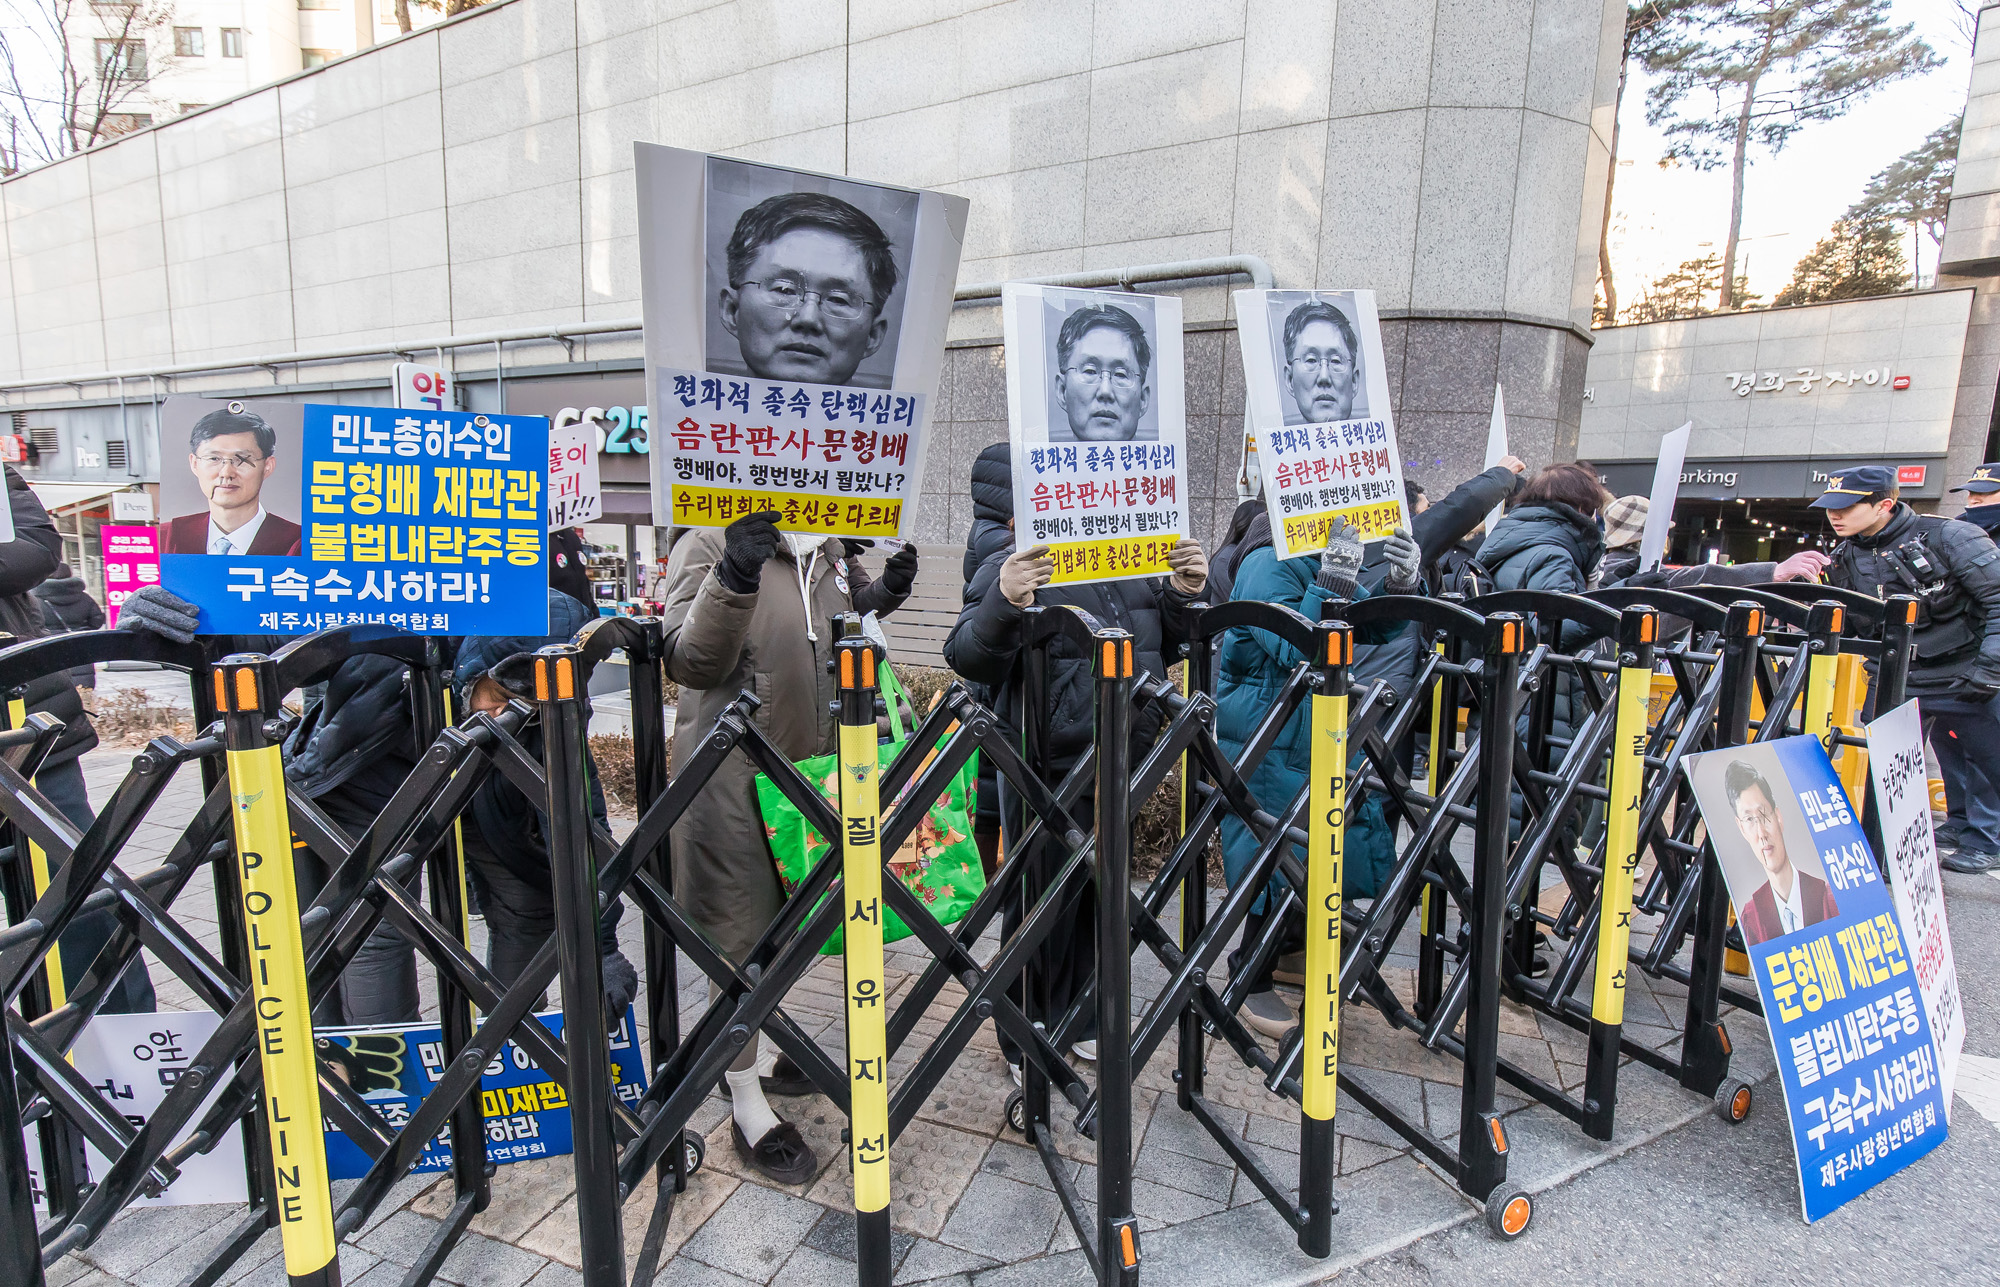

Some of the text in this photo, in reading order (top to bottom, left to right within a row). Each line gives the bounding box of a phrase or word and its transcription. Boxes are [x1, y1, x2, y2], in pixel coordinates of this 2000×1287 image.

[412, 372, 446, 411] 약
[673, 374, 915, 427] 편파적 졸속 탄핵심리
[332, 415, 511, 461] 민노총하수인
[1270, 420, 1386, 455] 편파적 졸속 탄핵심리
[673, 457, 905, 493] 행배야, 행번방서 뭘밨냐?
[1030, 444, 1175, 474] 편파적 졸속 탄핵심리
[1679, 470, 1738, 487] arking
[310, 461, 540, 520] 문형배 재판관
[549, 472, 580, 499] 괴
[1280, 491, 1317, 513] 행배야,
[1319, 484, 1360, 507] 행번방서
[782, 499, 839, 527] 출신은
[845, 502, 900, 530] 다르네
[1032, 511, 1179, 540] 행배야, 행번방서 뭘밨냐?
[1373, 505, 1402, 531] 다르네
[310, 523, 540, 566] 불법내란주동
[1037, 541, 1175, 575] 리법회장 출신은 다르
[227, 568, 490, 603] 구속수사하라!
[1799, 784, 1852, 832] 민노총
[1824, 840, 1877, 890] 하수인
[1323, 777, 1344, 1076] POLICE LINE
[1765, 935, 1846, 1024] 문형배
[1836, 912, 1908, 991] 재판관
[242, 852, 303, 1223] POLICE LINE
[1790, 986, 1920, 1087] 불법내란주동
[1803, 1043, 1936, 1151] 구속수사하라!
[1820, 1101, 1936, 1187] 제주사랑청년연합회
